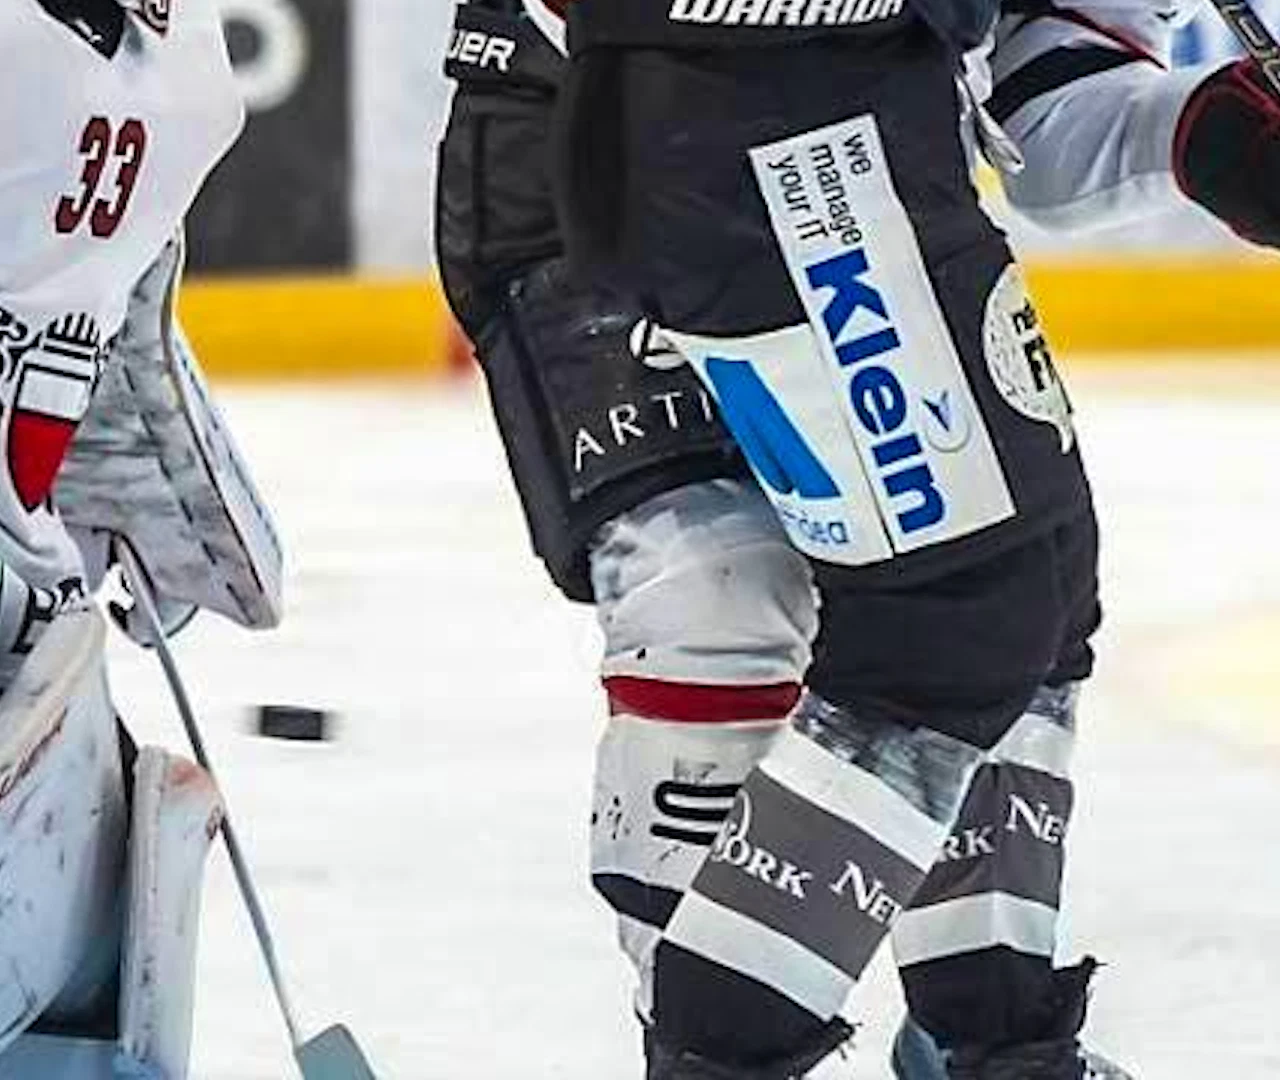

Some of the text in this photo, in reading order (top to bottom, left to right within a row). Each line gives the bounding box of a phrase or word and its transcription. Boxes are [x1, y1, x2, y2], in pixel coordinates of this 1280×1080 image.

[55, 115, 146, 238] 33
[768, 154, 829, 241] your IT
[809, 144, 862, 246] manage
[843, 133, 872, 175] we
[575, 389, 714, 473] ARTI
[805, 247, 947, 534] Klein
